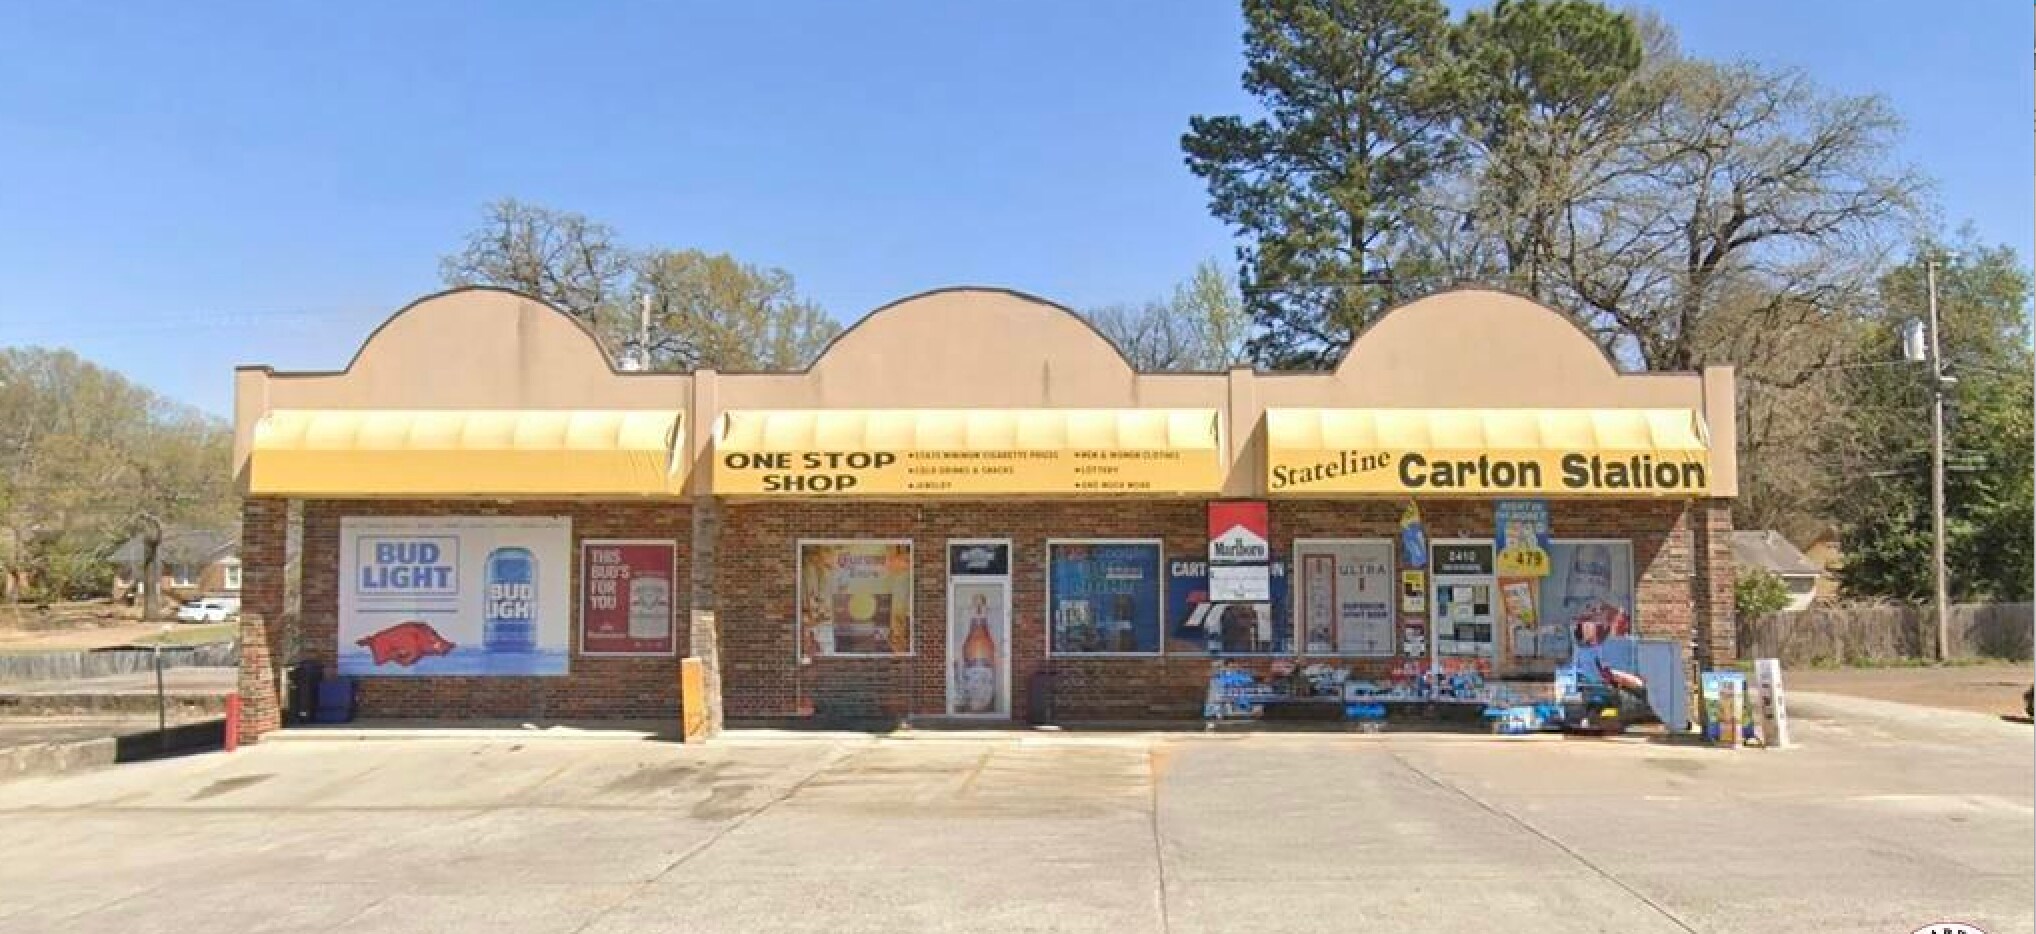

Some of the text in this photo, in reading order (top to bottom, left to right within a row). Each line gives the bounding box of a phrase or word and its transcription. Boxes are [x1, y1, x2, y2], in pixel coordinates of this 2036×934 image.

[724, 451, 896, 469] ONE STOP
[1271, 450, 1391, 489] Stateline
[1398, 452, 1707, 488] Carton Station
[762, 474, 858, 491] SHOP
[375, 542, 440, 564] BUD
[1215, 538, 1265, 556] Marlboro
[591, 549, 621, 564] THIS
[362, 566, 453, 589] LIGHT
[591, 565, 630, 579] BUD'S
[1339, 564, 1386, 575] ULTRA
[489, 583, 532, 600] BUD
[591, 580, 617, 595] FOR
[591, 596, 618, 611] YOU
